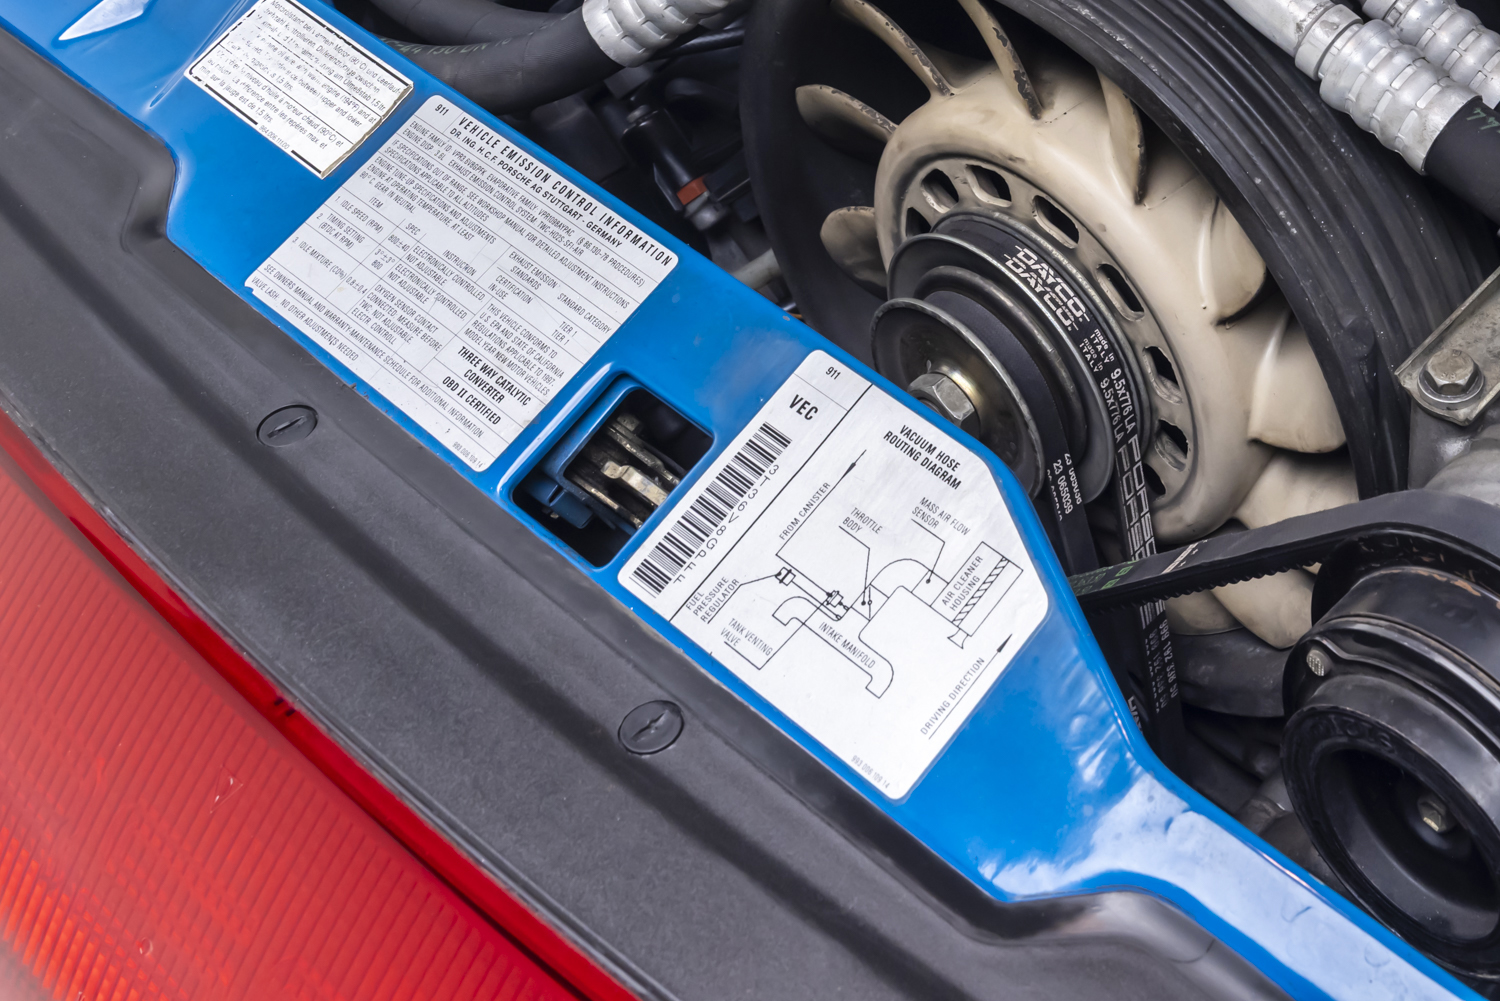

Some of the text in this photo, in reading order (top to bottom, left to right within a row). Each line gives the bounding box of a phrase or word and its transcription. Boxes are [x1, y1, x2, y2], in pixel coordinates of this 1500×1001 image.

[433, 102, 450, 116] 911
[408, 120, 430, 137] ENGINE
[426, 132, 447, 148] FAMILY
[485, 173, 521, 199] EVAPORATIVE
[368, 196, 384, 209] ITEM
[374, 155, 497, 245] ENGINE TUNE-UP SPECIFICATIONS AND ADJUSTMENTS
[383, 145, 490, 222] SPECIFICATIONS APPLICABLE TO ALL ALTITUDES
[448, 127, 623, 248] DR. ING. H.C.F. PORSCHE AG STUTTGART GERMANY
[457, 116, 673, 267] VEHICLE EMISSION CONTROL INFORMATION
[390, 138, 400, 146] IF
[395, 141, 435, 171] SPECIFICATIONS
[431, 166, 445, 178] OUT
[440, 173, 452, 182] OF
[465, 190, 480, 202] SEE
[475, 197, 507, 220] WORKSHOP
[502, 216, 527, 236] MANUAL
[523, 231, 538, 244] FOR
[534, 238, 561, 260] DETAILED
[557, 255, 595, 283] ADJUSTMENT
[590, 278, 630, 309] INSTRUCTIONS
[404, 222, 421, 236] SPEC
[494, 274, 534, 305] CERTIFICATION
[508, 251, 558, 289] EXHAUST EMISSION
[509, 265, 542, 291] STANDARDS
[1016, 246, 1088, 322] DAYCO
[487, 282, 509, 300] IN-USE
[485, 303, 558, 359] THIS VEHICLE CONFORMS TO
[555, 292, 612, 334] STANDARD CATEGORY
[558, 320, 578, 338] TIER 1
[1090, 333, 1111, 364] ITALY
[456, 345, 532, 406] THREE WAY CATALYTIC
[462, 368, 505, 404] CONVERTER
[824, 365, 841, 380] 911
[441, 375, 502, 425] OBD II CERTIFIED
[787, 394, 819, 421] VEC
[881, 430, 962, 490] ROUTING DIAGRAM
[897, 424, 961, 472] VACUUM HOSE
[1053, 459, 1063, 474] 23
[778, 481, 831, 541] FROM CANISTER
[1057, 474, 1073, 515] 065039
[841, 516, 863, 533] BODY
[849, 506, 883, 534] THROTTLE
[910, 505, 940, 529] SENSOR
[918, 496, 971, 536] MASS AIR FLOW
[684, 590, 705, 611] FUEL
[692, 575, 729, 617] PRESSURE
[699, 577, 740, 623] REGULATOR
[940, 554, 984, 606] AIR CLEANER
[948, 573, 981, 613] HOUSING
[719, 626, 741, 647] VALVE
[727, 616, 773, 657] TANK VENTING
[817, 620, 876, 669] INTAKE MANIFOLD
[919, 655, 985, 736] DRIVING DIRECTION
